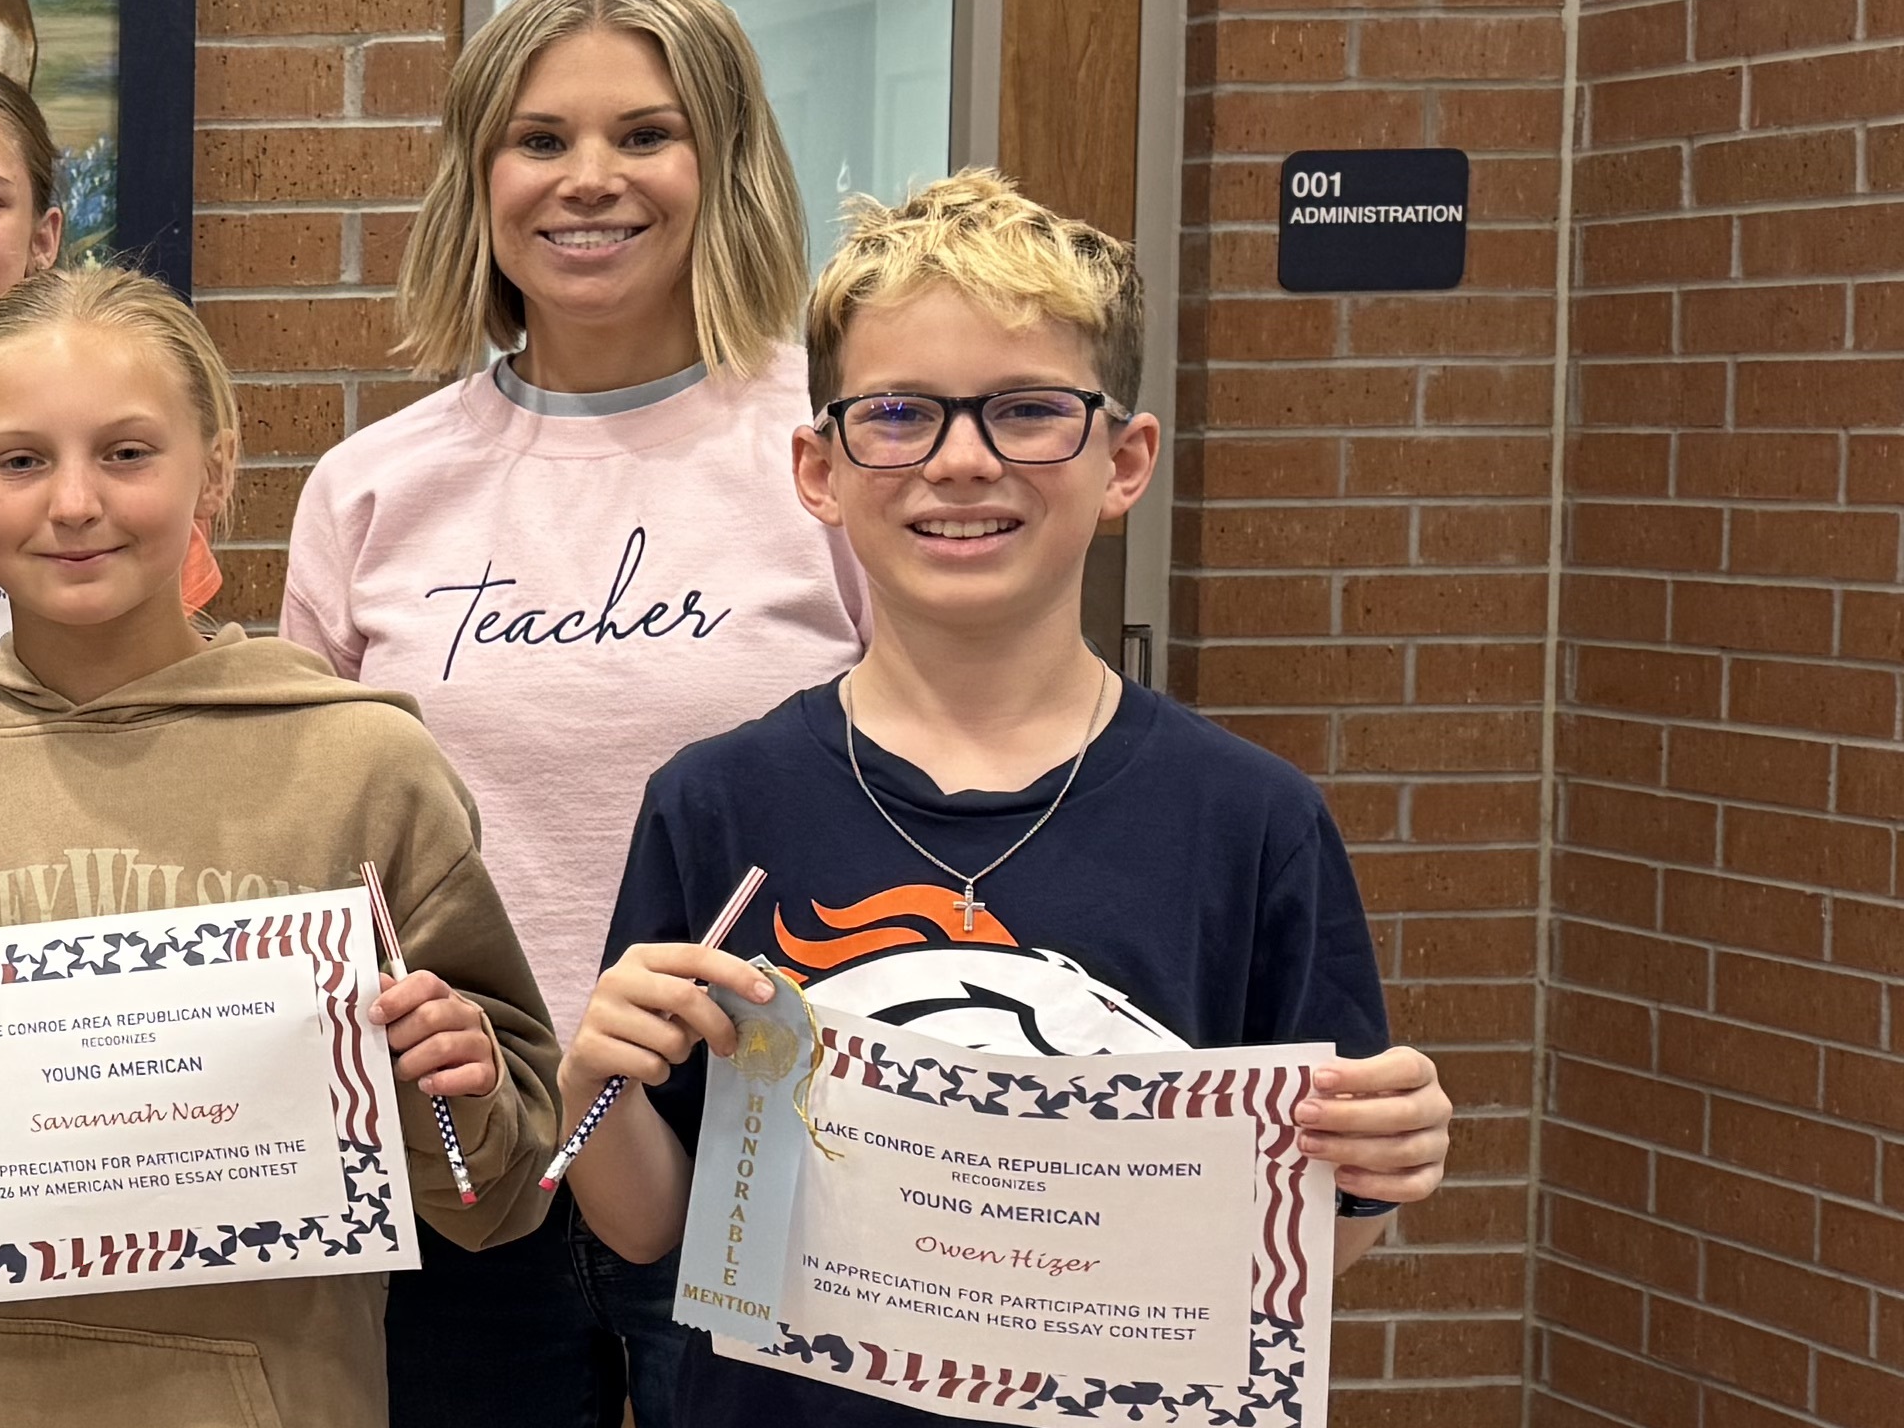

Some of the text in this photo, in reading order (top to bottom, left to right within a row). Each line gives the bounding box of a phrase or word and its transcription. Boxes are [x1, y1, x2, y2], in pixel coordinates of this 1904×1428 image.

[1291, 171, 1342, 198] 001
[1290, 204, 1464, 225] ADMINISTRATION
[426, 527, 731, 680] Teacher
[7, 1019, 67, 1036] CONROE
[71, 1015, 112, 1031] AREA
[116, 1006, 212, 1027] REPUBLICAN
[216, 1001, 275, 1018] WOMEN
[81, 1032, 156, 1048] RECOGNIZES
[41, 1056, 203, 1083] YOUNG AMERICAN
[30, 1102, 240, 1133] Savannah Nagy
[101, 1155, 132, 1170] FOR
[136, 1145, 250, 1168] PARTICIPATING
[254, 1143, 271, 1157] IN
[273, 1139, 307, 1155] THE
[813, 1117, 1202, 1177] LAKE CONROE AREA REPUBLICAN WOMEN
[19, 1184, 40, 1198] MY
[45, 1178, 124, 1196] AMERICAN
[128, 1174, 170, 1189] HERO
[174, 1168, 223, 1185] ESSAY
[228, 1161, 298, 1181] CONTEST
[723, 1092, 764, 1297] HONORABLE
[951, 1171, 1047, 1192] RECOGNIZES
[899, 1186, 1100, 1226] YOUNG AMERICAN
[915, 1236, 1101, 1277] Owen Hizer
[682, 1282, 772, 1321] MENTION
[802, 1254, 1210, 1321] IN APPRECIATION FOR PARTICIPATING IN THE
[813, 1278, 1197, 1341] 2026 MY AMERICAN HERO ESSAY CONTEST
